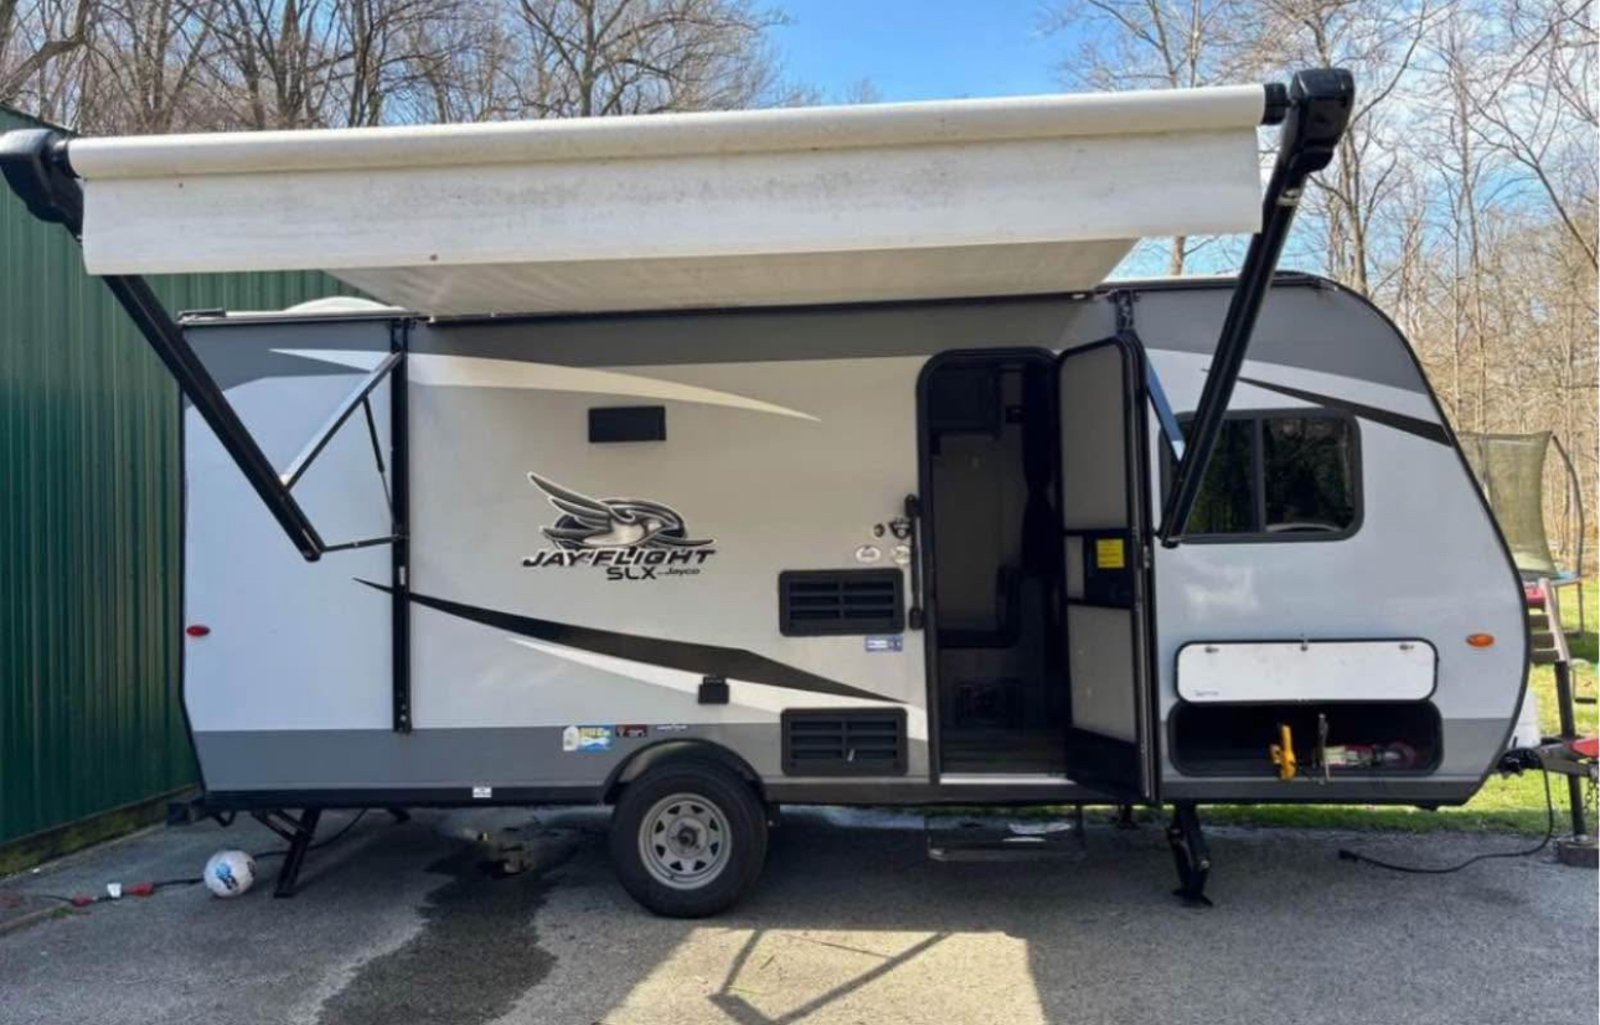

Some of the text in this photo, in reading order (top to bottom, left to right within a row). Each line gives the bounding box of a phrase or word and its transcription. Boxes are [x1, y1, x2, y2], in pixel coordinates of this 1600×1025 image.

[522, 549, 716, 567] JAY FLIGHT
[606, 566, 657, 580] SLX
